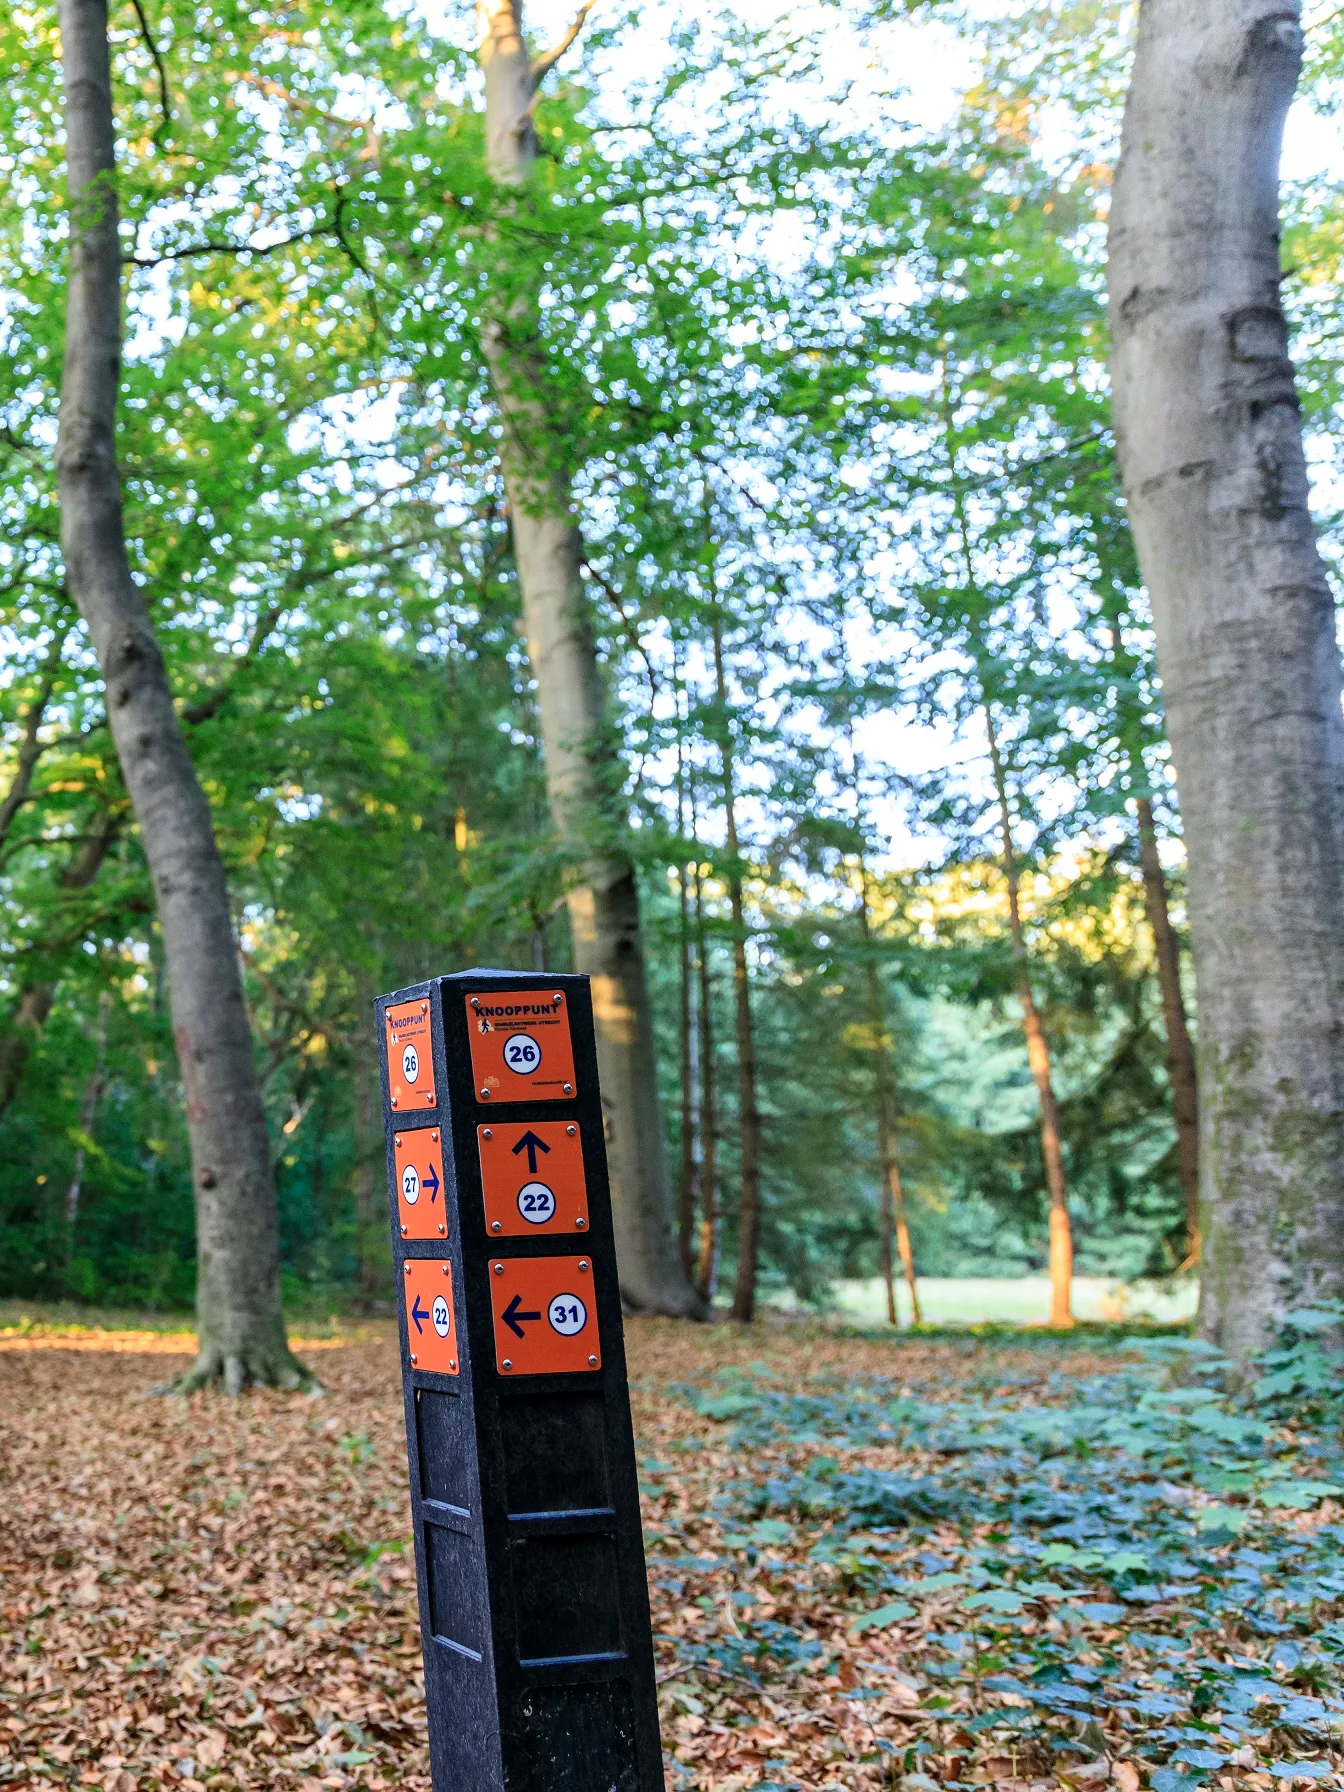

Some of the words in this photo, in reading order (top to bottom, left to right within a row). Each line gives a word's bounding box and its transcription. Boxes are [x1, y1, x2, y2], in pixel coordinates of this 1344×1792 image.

[475, 1003, 559, 1017] KNOOPPUNT
[390, 1014, 426, 1029] KNOOPPUNT
[508, 1044, 536, 1063] 26
[404, 1055, 417, 1073] 26
[404, 1177, 417, 1194] 27
[523, 1193, 550, 1212] 22
[434, 1307, 448, 1326] 22
[554, 1304, 579, 1324] 31
